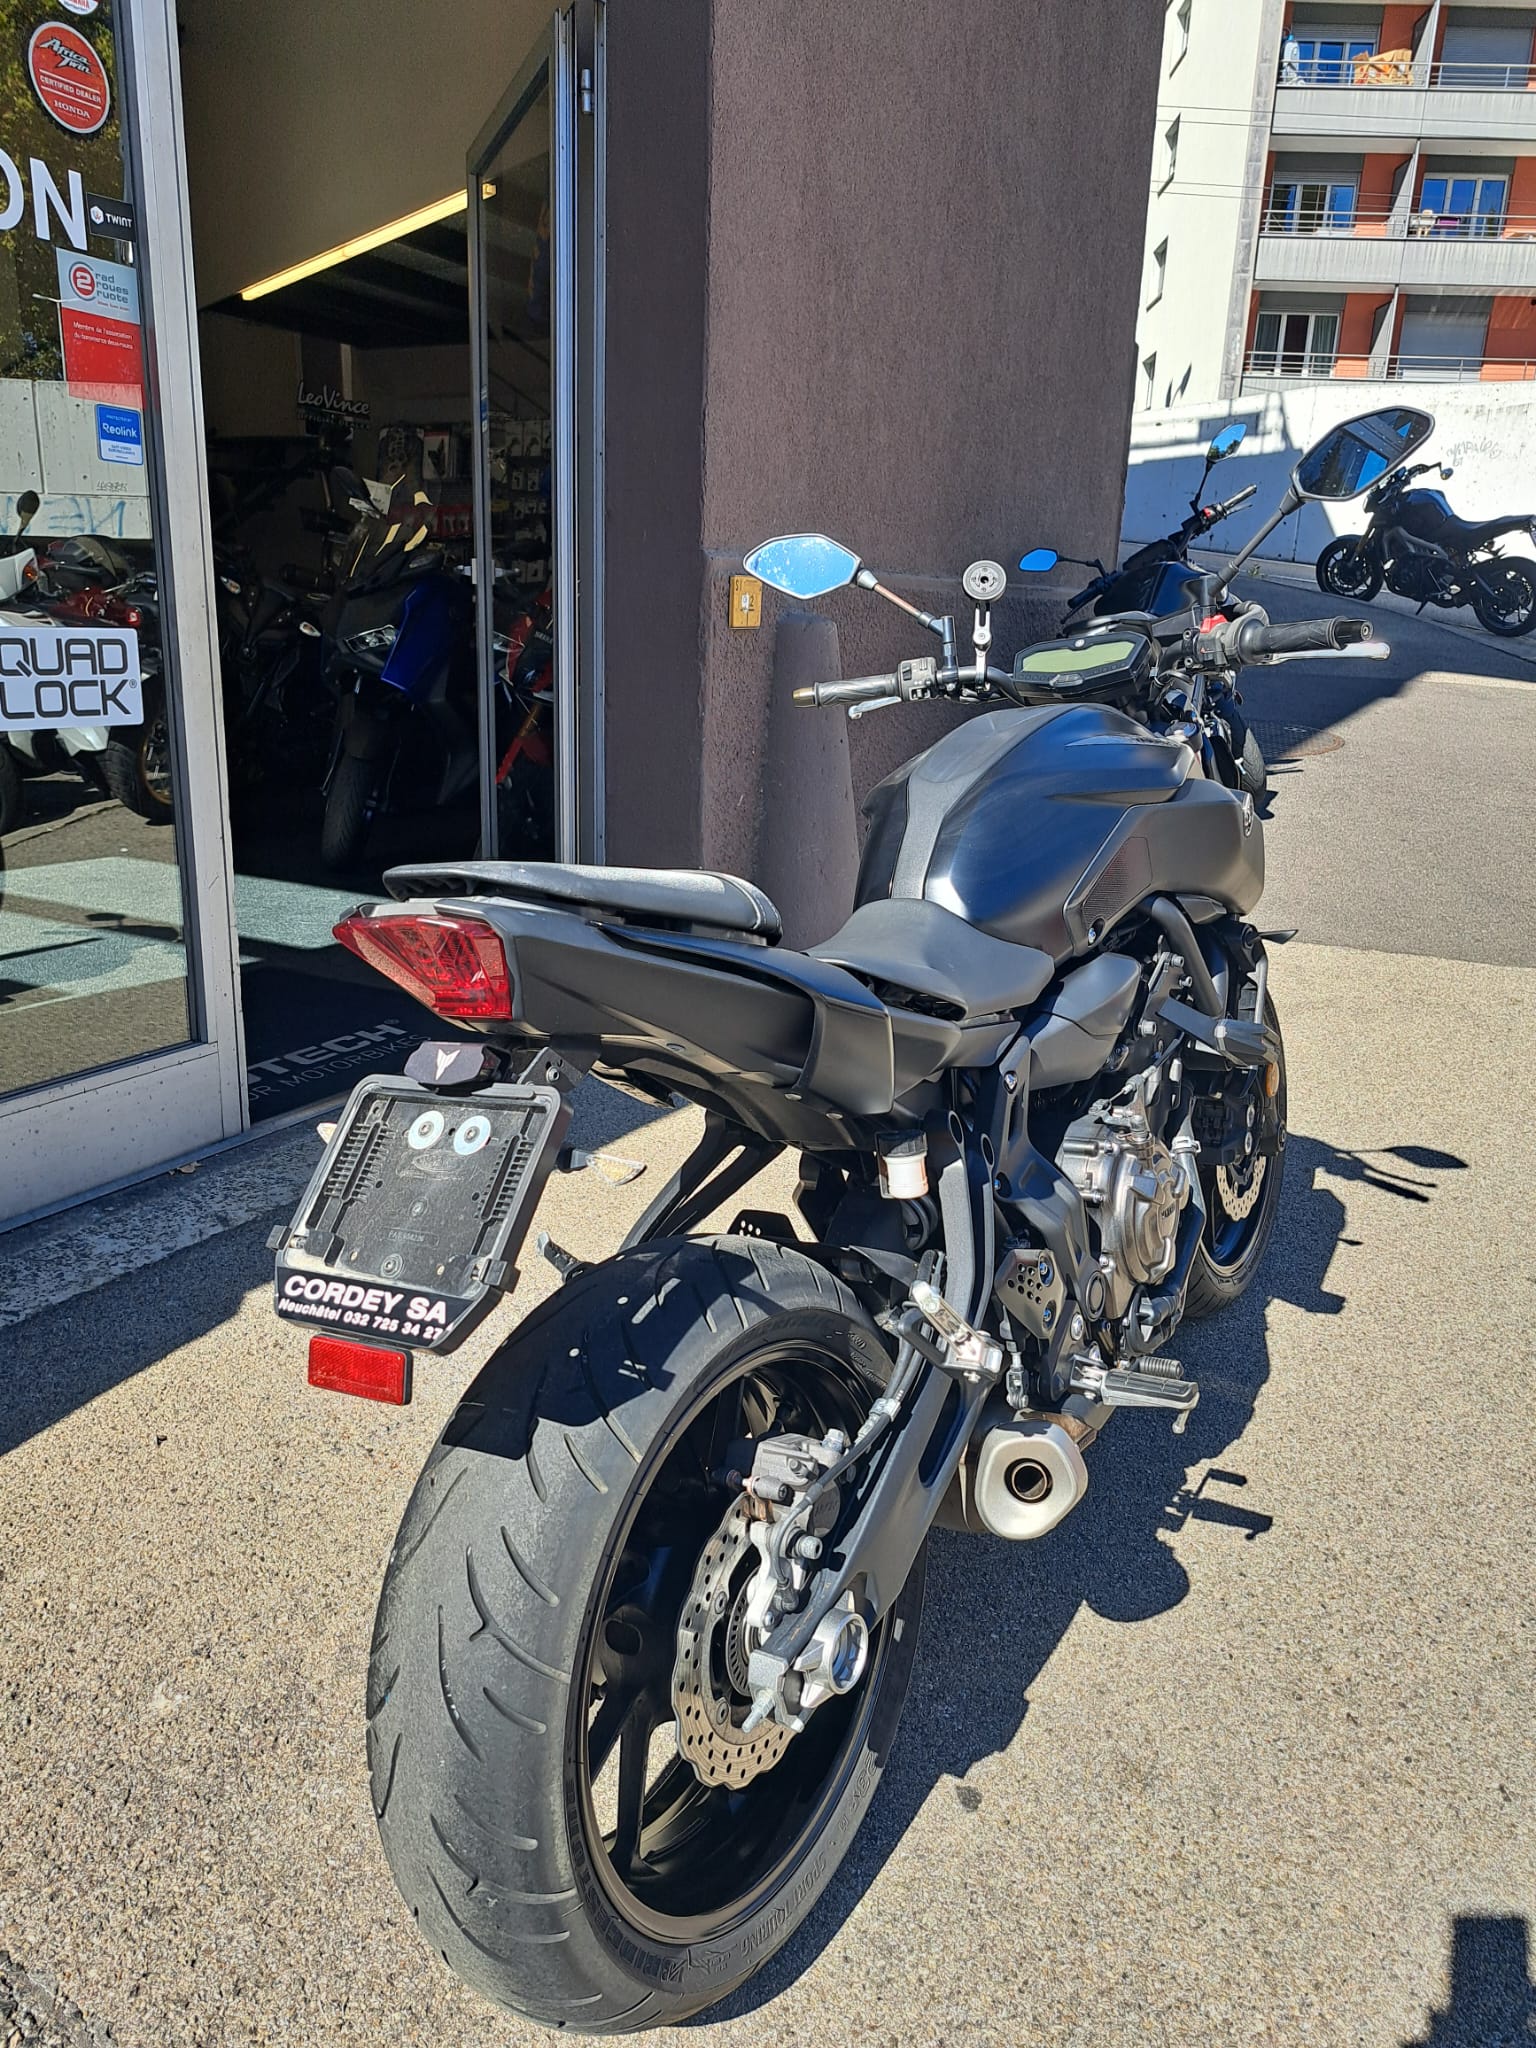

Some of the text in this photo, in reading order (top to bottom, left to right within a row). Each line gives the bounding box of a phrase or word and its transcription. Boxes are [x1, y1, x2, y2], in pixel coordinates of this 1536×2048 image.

[40, 38, 89, 65] Africa
[57, 55, 92, 74] Twin
[40, 75, 102, 104] CERTIFIED DEALER
[54, 99, 90, 119] HONDA
[105, 213, 133, 228] TWINT
[75, 270, 93, 292] 2
[95, 272, 115, 283] rad
[96, 281, 129, 296] roues
[96, 290, 129, 304] ruote
[297, 381, 370, 415] LeoVince
[102, 422, 138, 439] Reolink
[0, 638, 127, 677] QUAD
[278, 1033, 432, 1088] MOTORBIKES
[284, 1275, 447, 1325] CORDEY SA
[278, 1297, 444, 1340] Neuchâtel 032 725 34 27
[739, 1851, 827, 1956] SPORT TOURING
